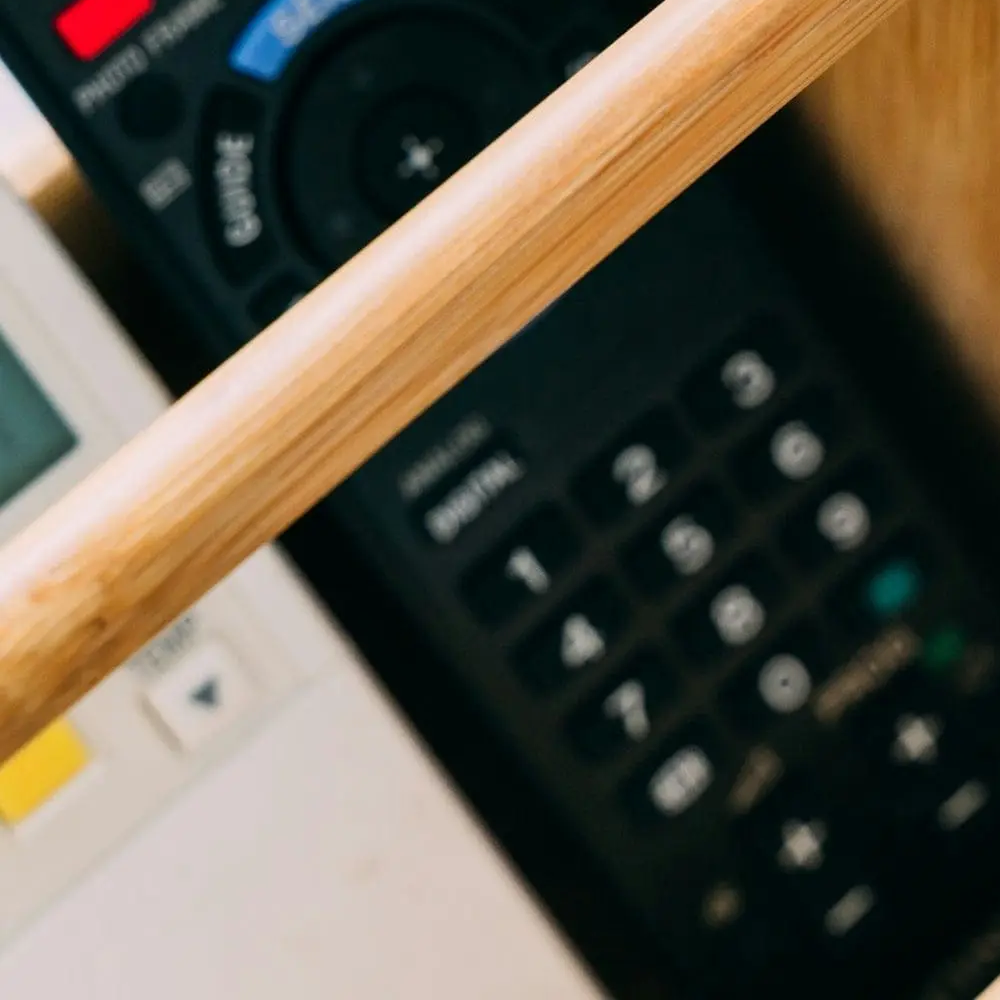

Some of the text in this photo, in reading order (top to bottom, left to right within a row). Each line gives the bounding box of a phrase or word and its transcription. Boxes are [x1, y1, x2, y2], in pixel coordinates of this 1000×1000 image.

[214, 132, 262, 247] GUIDE
[721, 350, 775, 408] 3
[613, 444, 668, 504] 2
[506, 546, 550, 593] 1
[661, 514, 714, 575] 5
[561, 613, 605, 667] 4
[605, 679, 650, 740] 7
